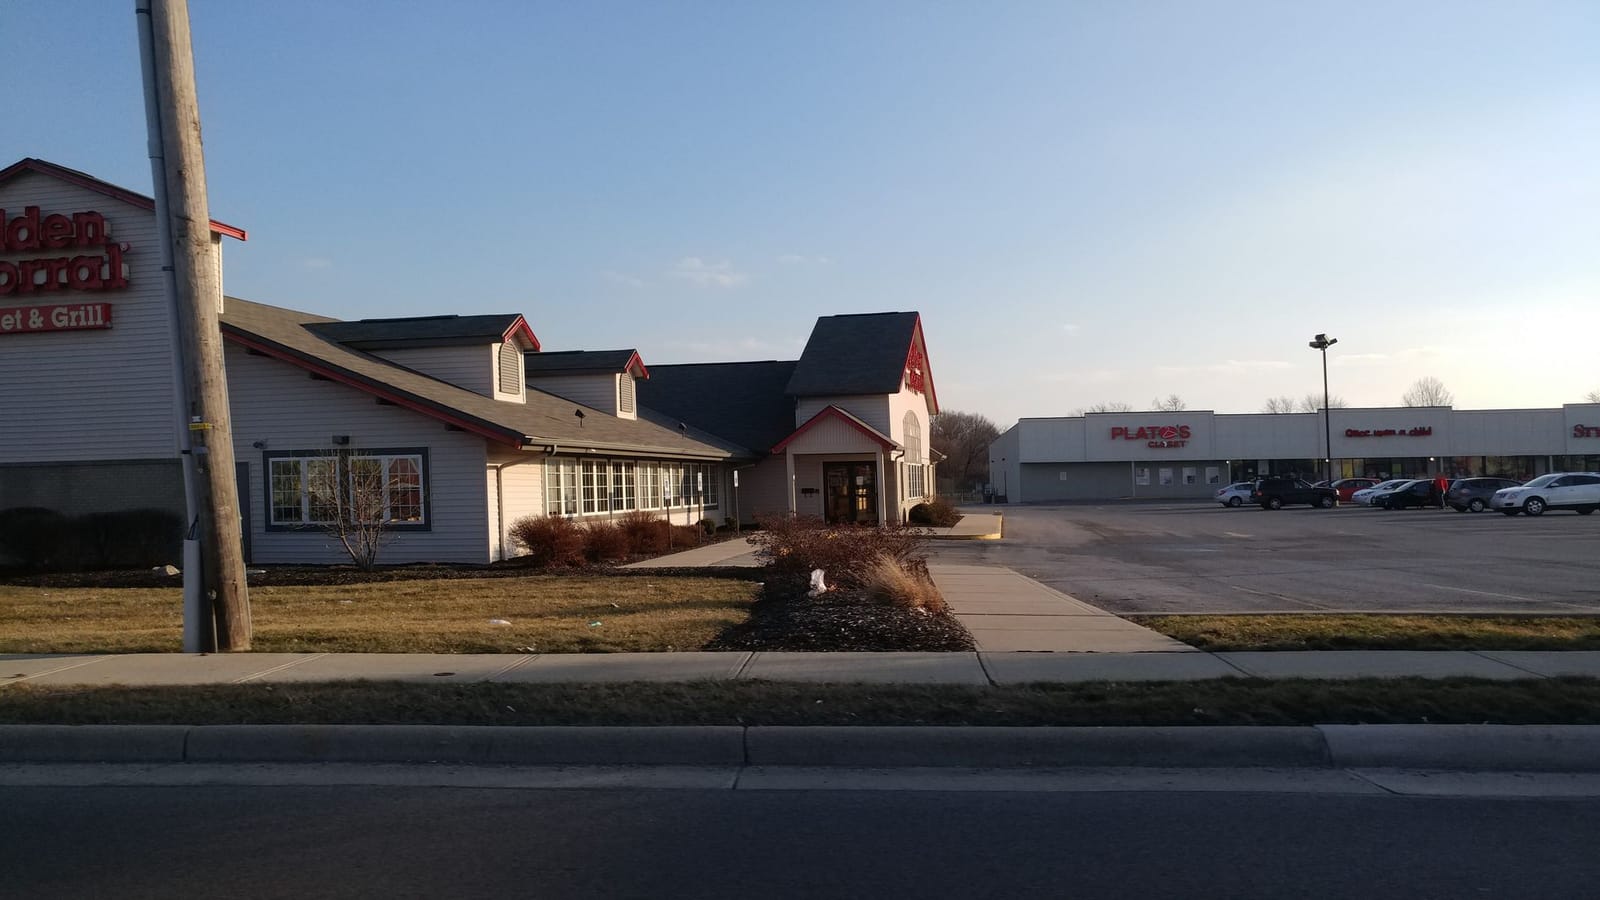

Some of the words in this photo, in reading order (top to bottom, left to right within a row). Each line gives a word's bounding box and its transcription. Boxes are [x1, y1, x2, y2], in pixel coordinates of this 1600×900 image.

[28, 308, 44, 329] &
[51, 305, 104, 327] Grill
[1111, 424, 1191, 440] PLATO'S
[1147, 440, 1185, 448] CLOSET
